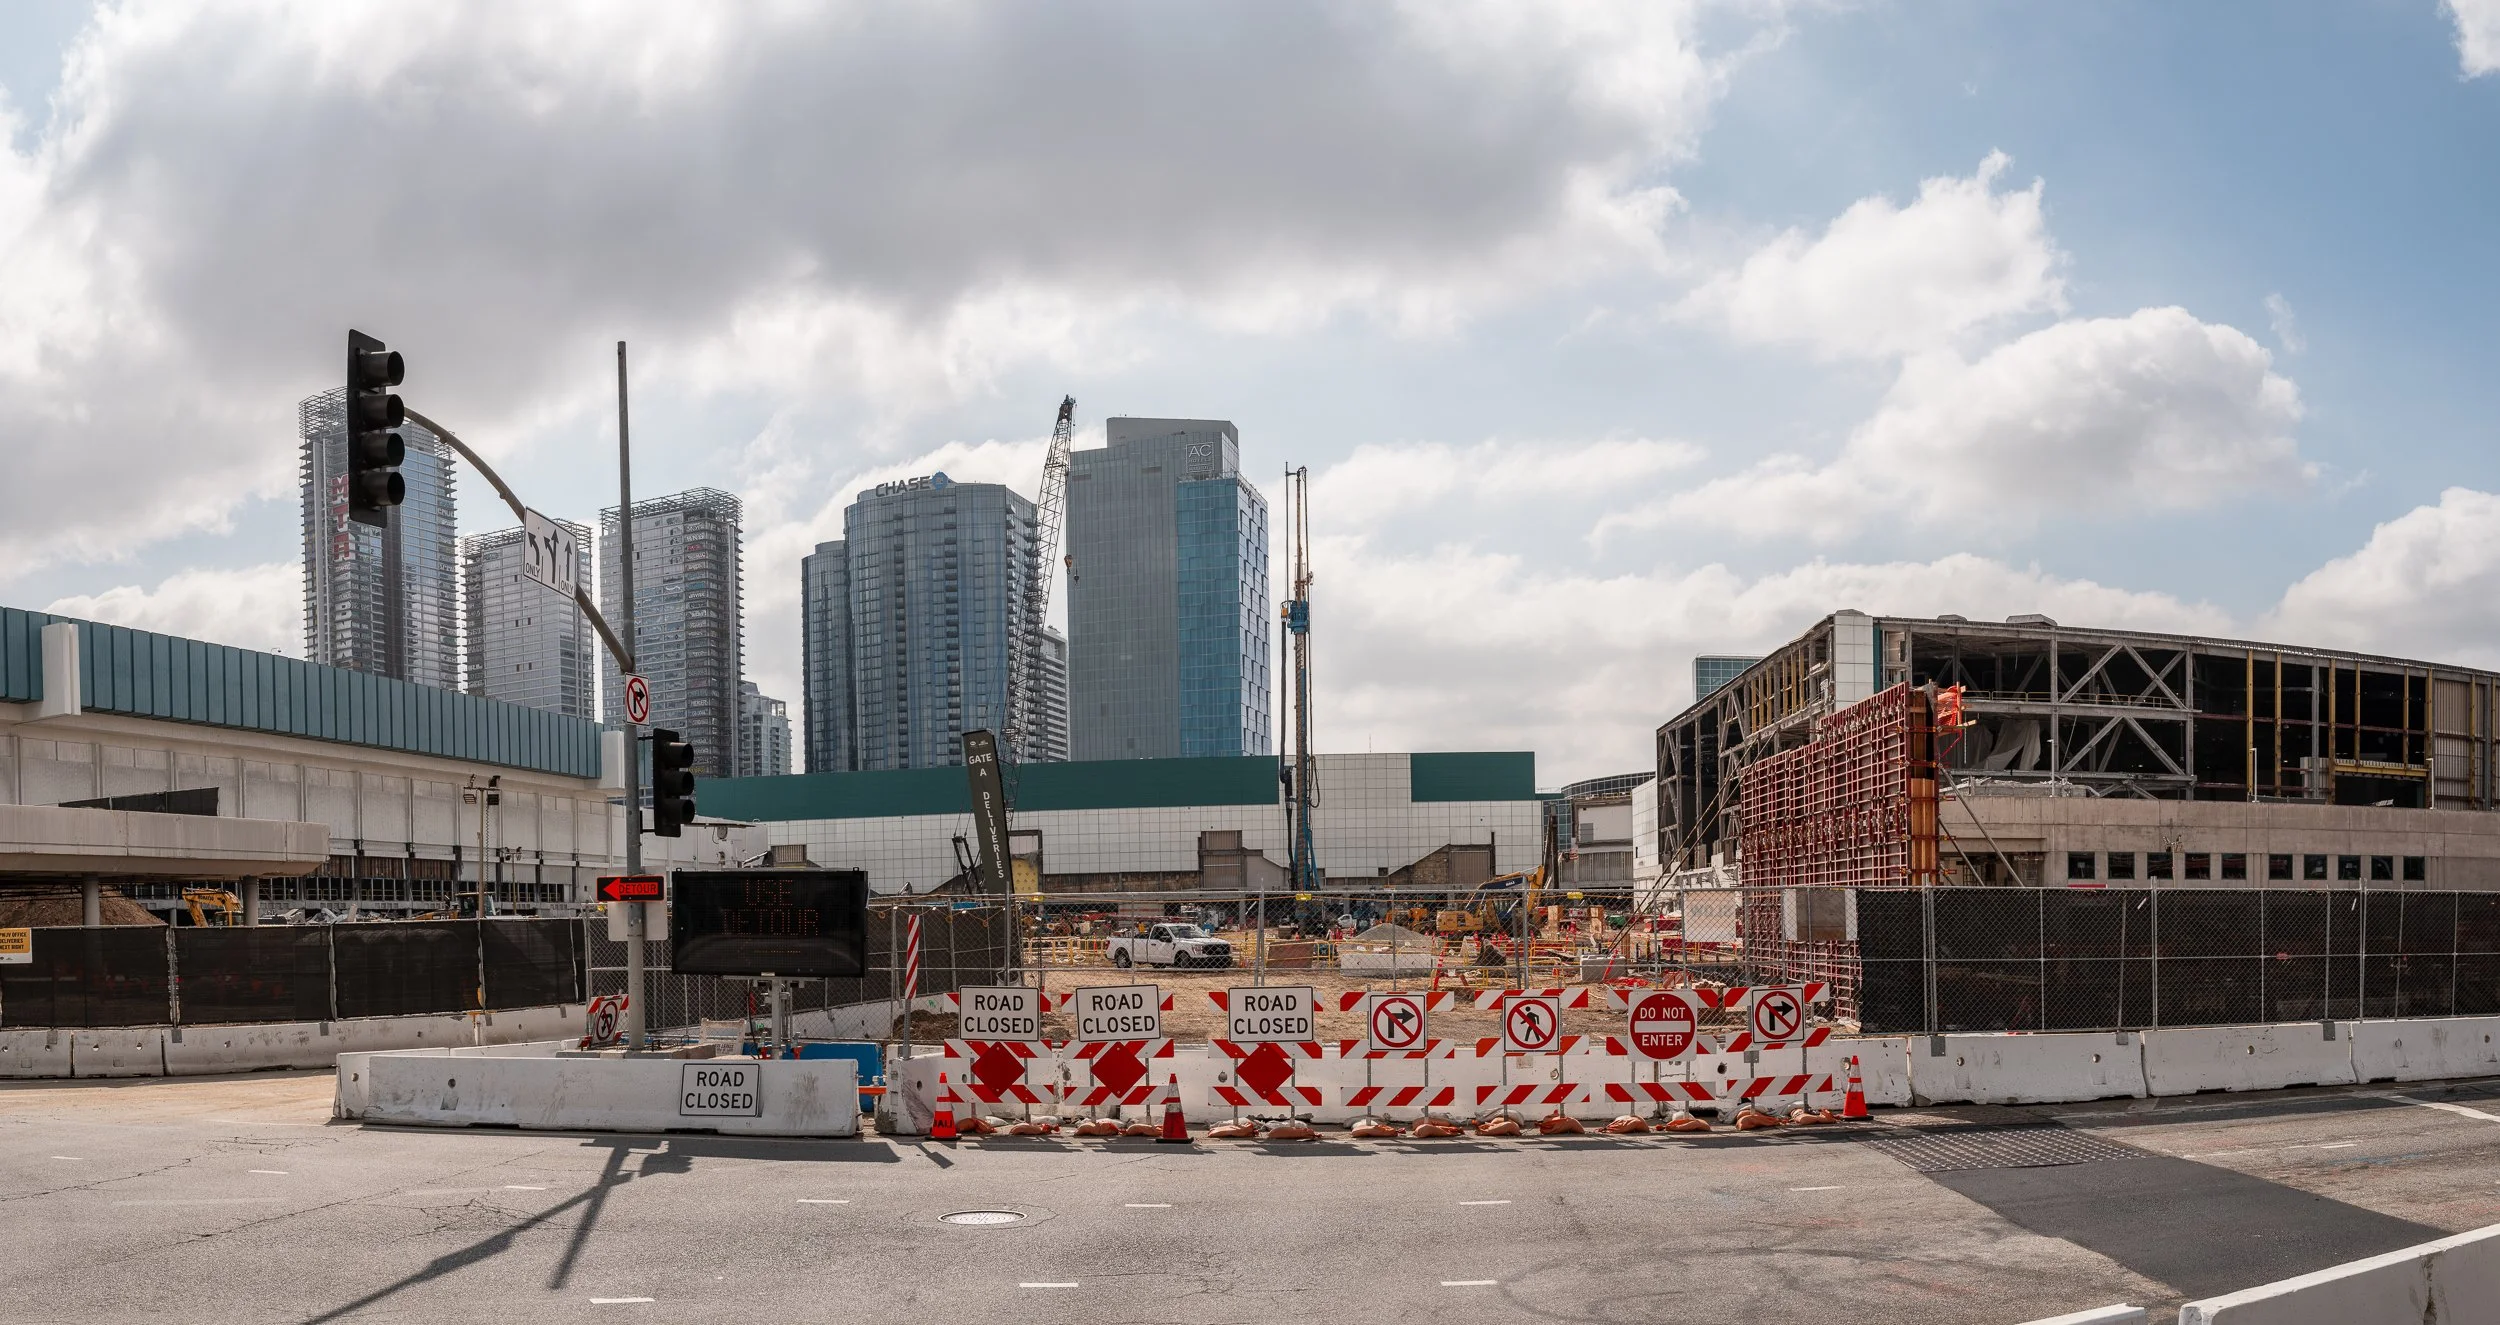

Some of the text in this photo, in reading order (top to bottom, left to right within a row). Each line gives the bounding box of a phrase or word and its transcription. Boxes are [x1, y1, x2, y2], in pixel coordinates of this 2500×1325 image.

[1188, 444, 1212, 458] AC
[875, 475, 931, 498] CHASE
[525, 562, 541, 577] ONLY
[560, 580, 574, 595] ONLY
[968, 752, 993, 765] GATE
[979, 767, 987, 777] A
[982, 791, 1005, 879] DELIVERIES
[618, 883, 658, 895] DETOUR
[746, 879, 793, 906] USE
[721, 908, 819, 936] DETOUR
[974, 994, 1024, 1011] ROAD
[1091, 993, 1143, 1011] ROAD
[1244, 994, 1297, 1011] ROAD
[1640, 1007, 1686, 1019] DO NOT
[964, 1016, 1034, 1034] CLOSED
[1082, 1015, 1155, 1034] CLOSED
[1234, 1017, 1308, 1034] CLOSED
[1641, 1034, 1683, 1046] ENTER
[696, 1071, 744, 1087] ROAD
[685, 1092, 753, 1109] CLOSED
